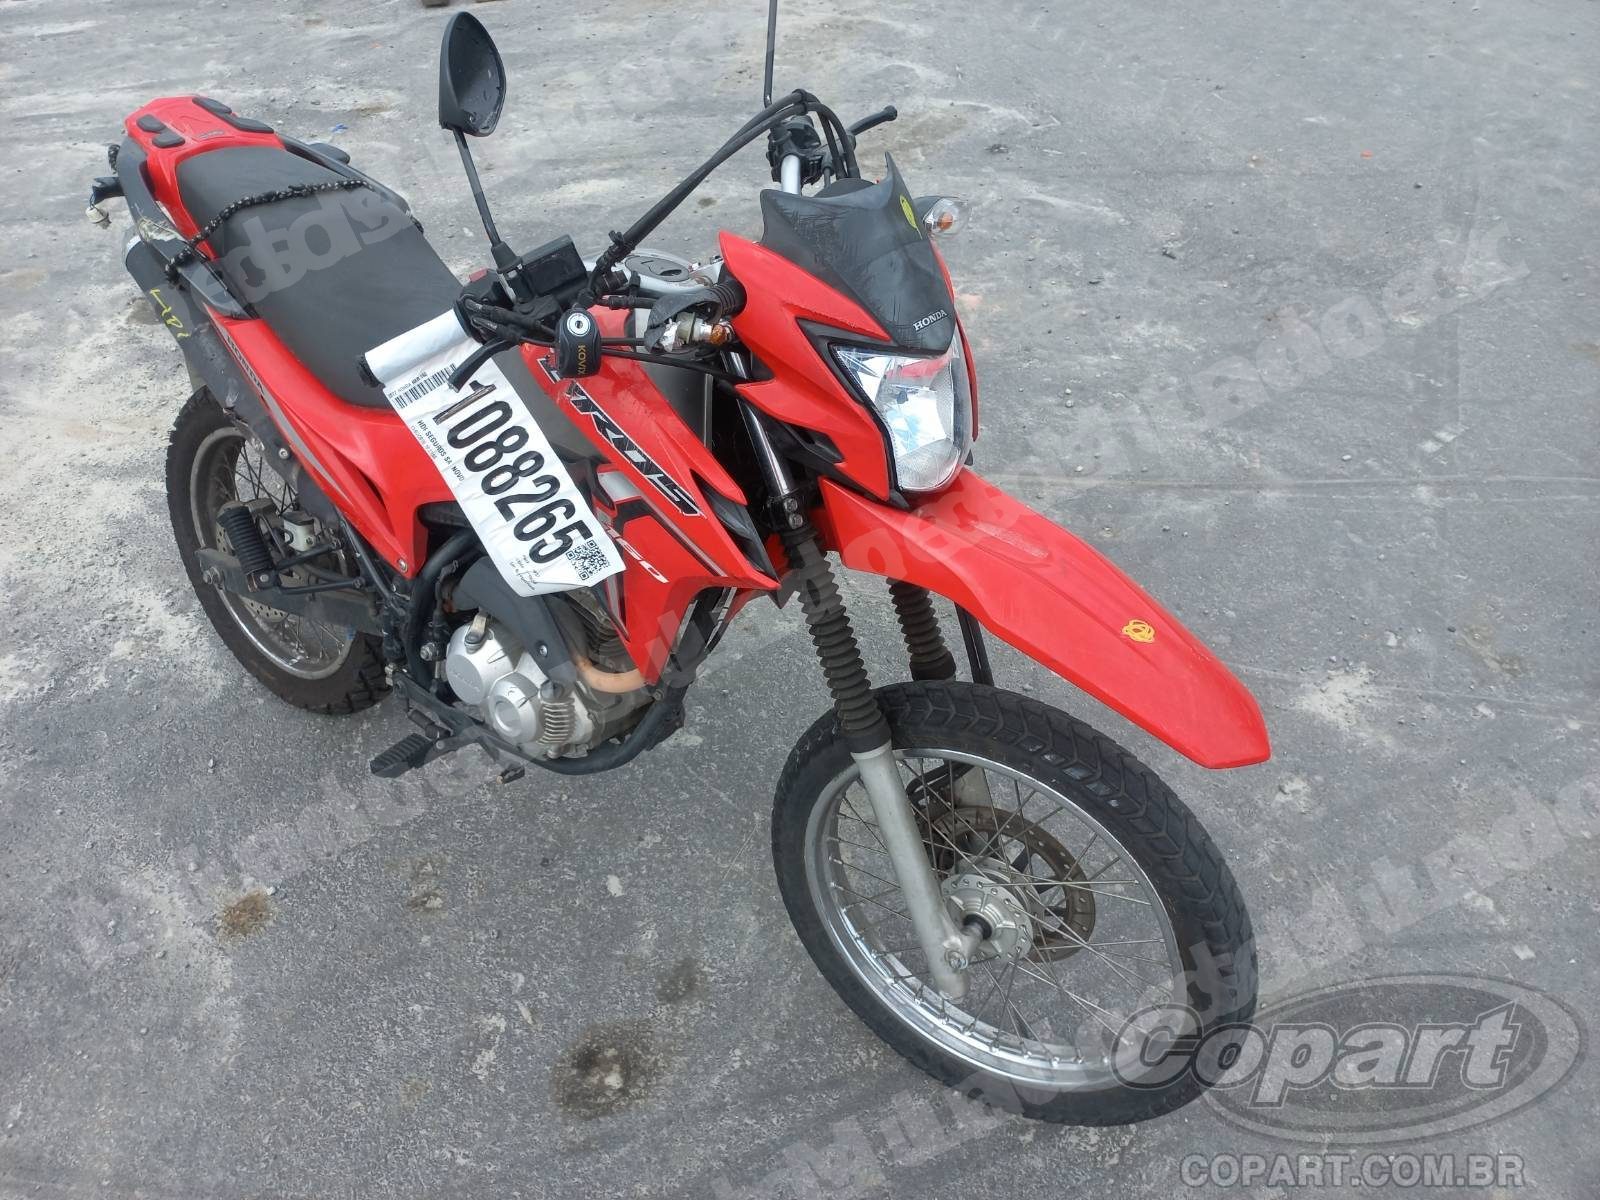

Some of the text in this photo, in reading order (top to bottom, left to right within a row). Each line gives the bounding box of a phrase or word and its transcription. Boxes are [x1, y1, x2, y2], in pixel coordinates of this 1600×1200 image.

[912, 309, 948, 332] HONDA
[577, 345, 586, 375] KOVIX
[425, 430, 447, 457] SEGUROS
[433, 380, 593, 564] 1088265
